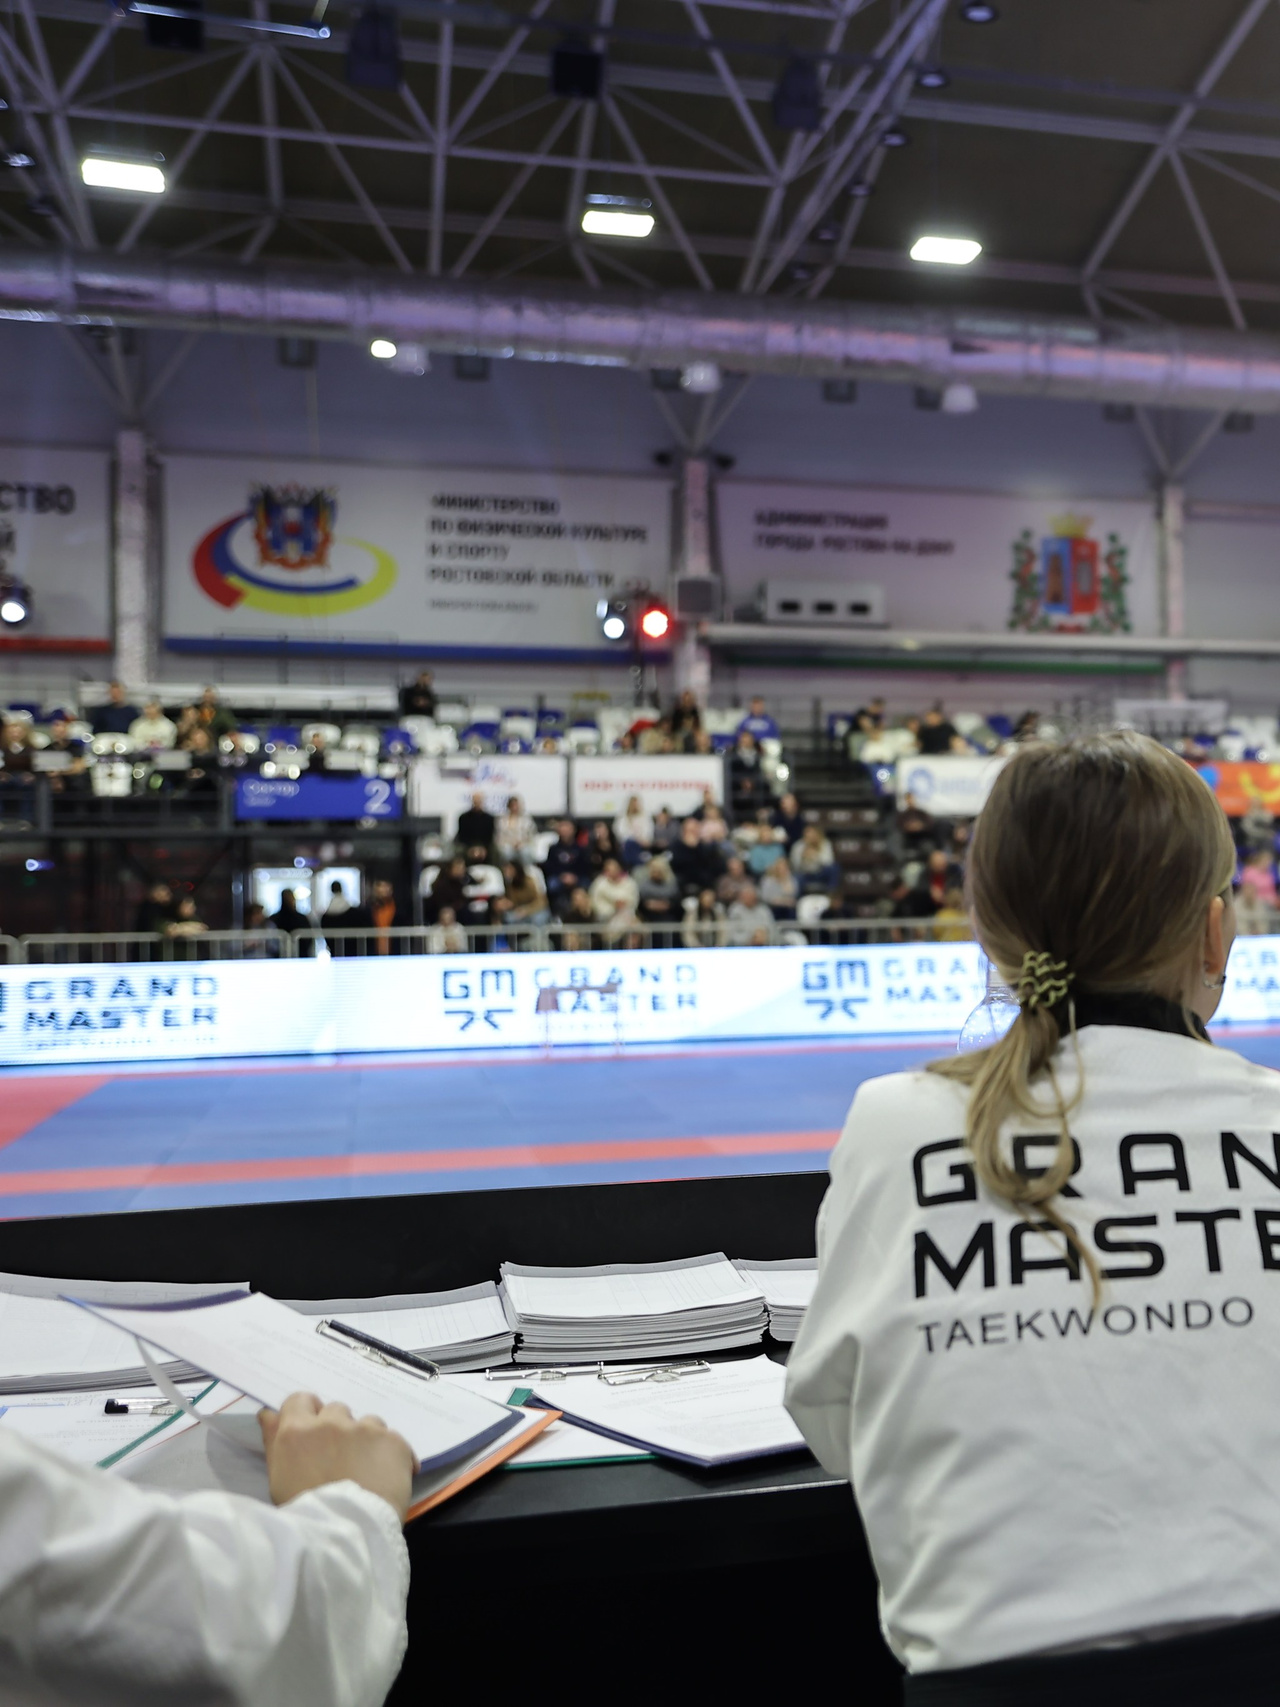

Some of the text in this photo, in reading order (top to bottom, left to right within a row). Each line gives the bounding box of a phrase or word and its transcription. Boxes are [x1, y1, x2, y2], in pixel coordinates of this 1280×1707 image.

[364, 779, 391, 815] 2
[26, 976, 216, 1001] GRAND
[443, 969, 514, 999] GM
[803, 960, 869, 990] GM
[26, 1006, 216, 1031] MASTER
[918, 1297, 1254, 1354] TAEKWONDO
